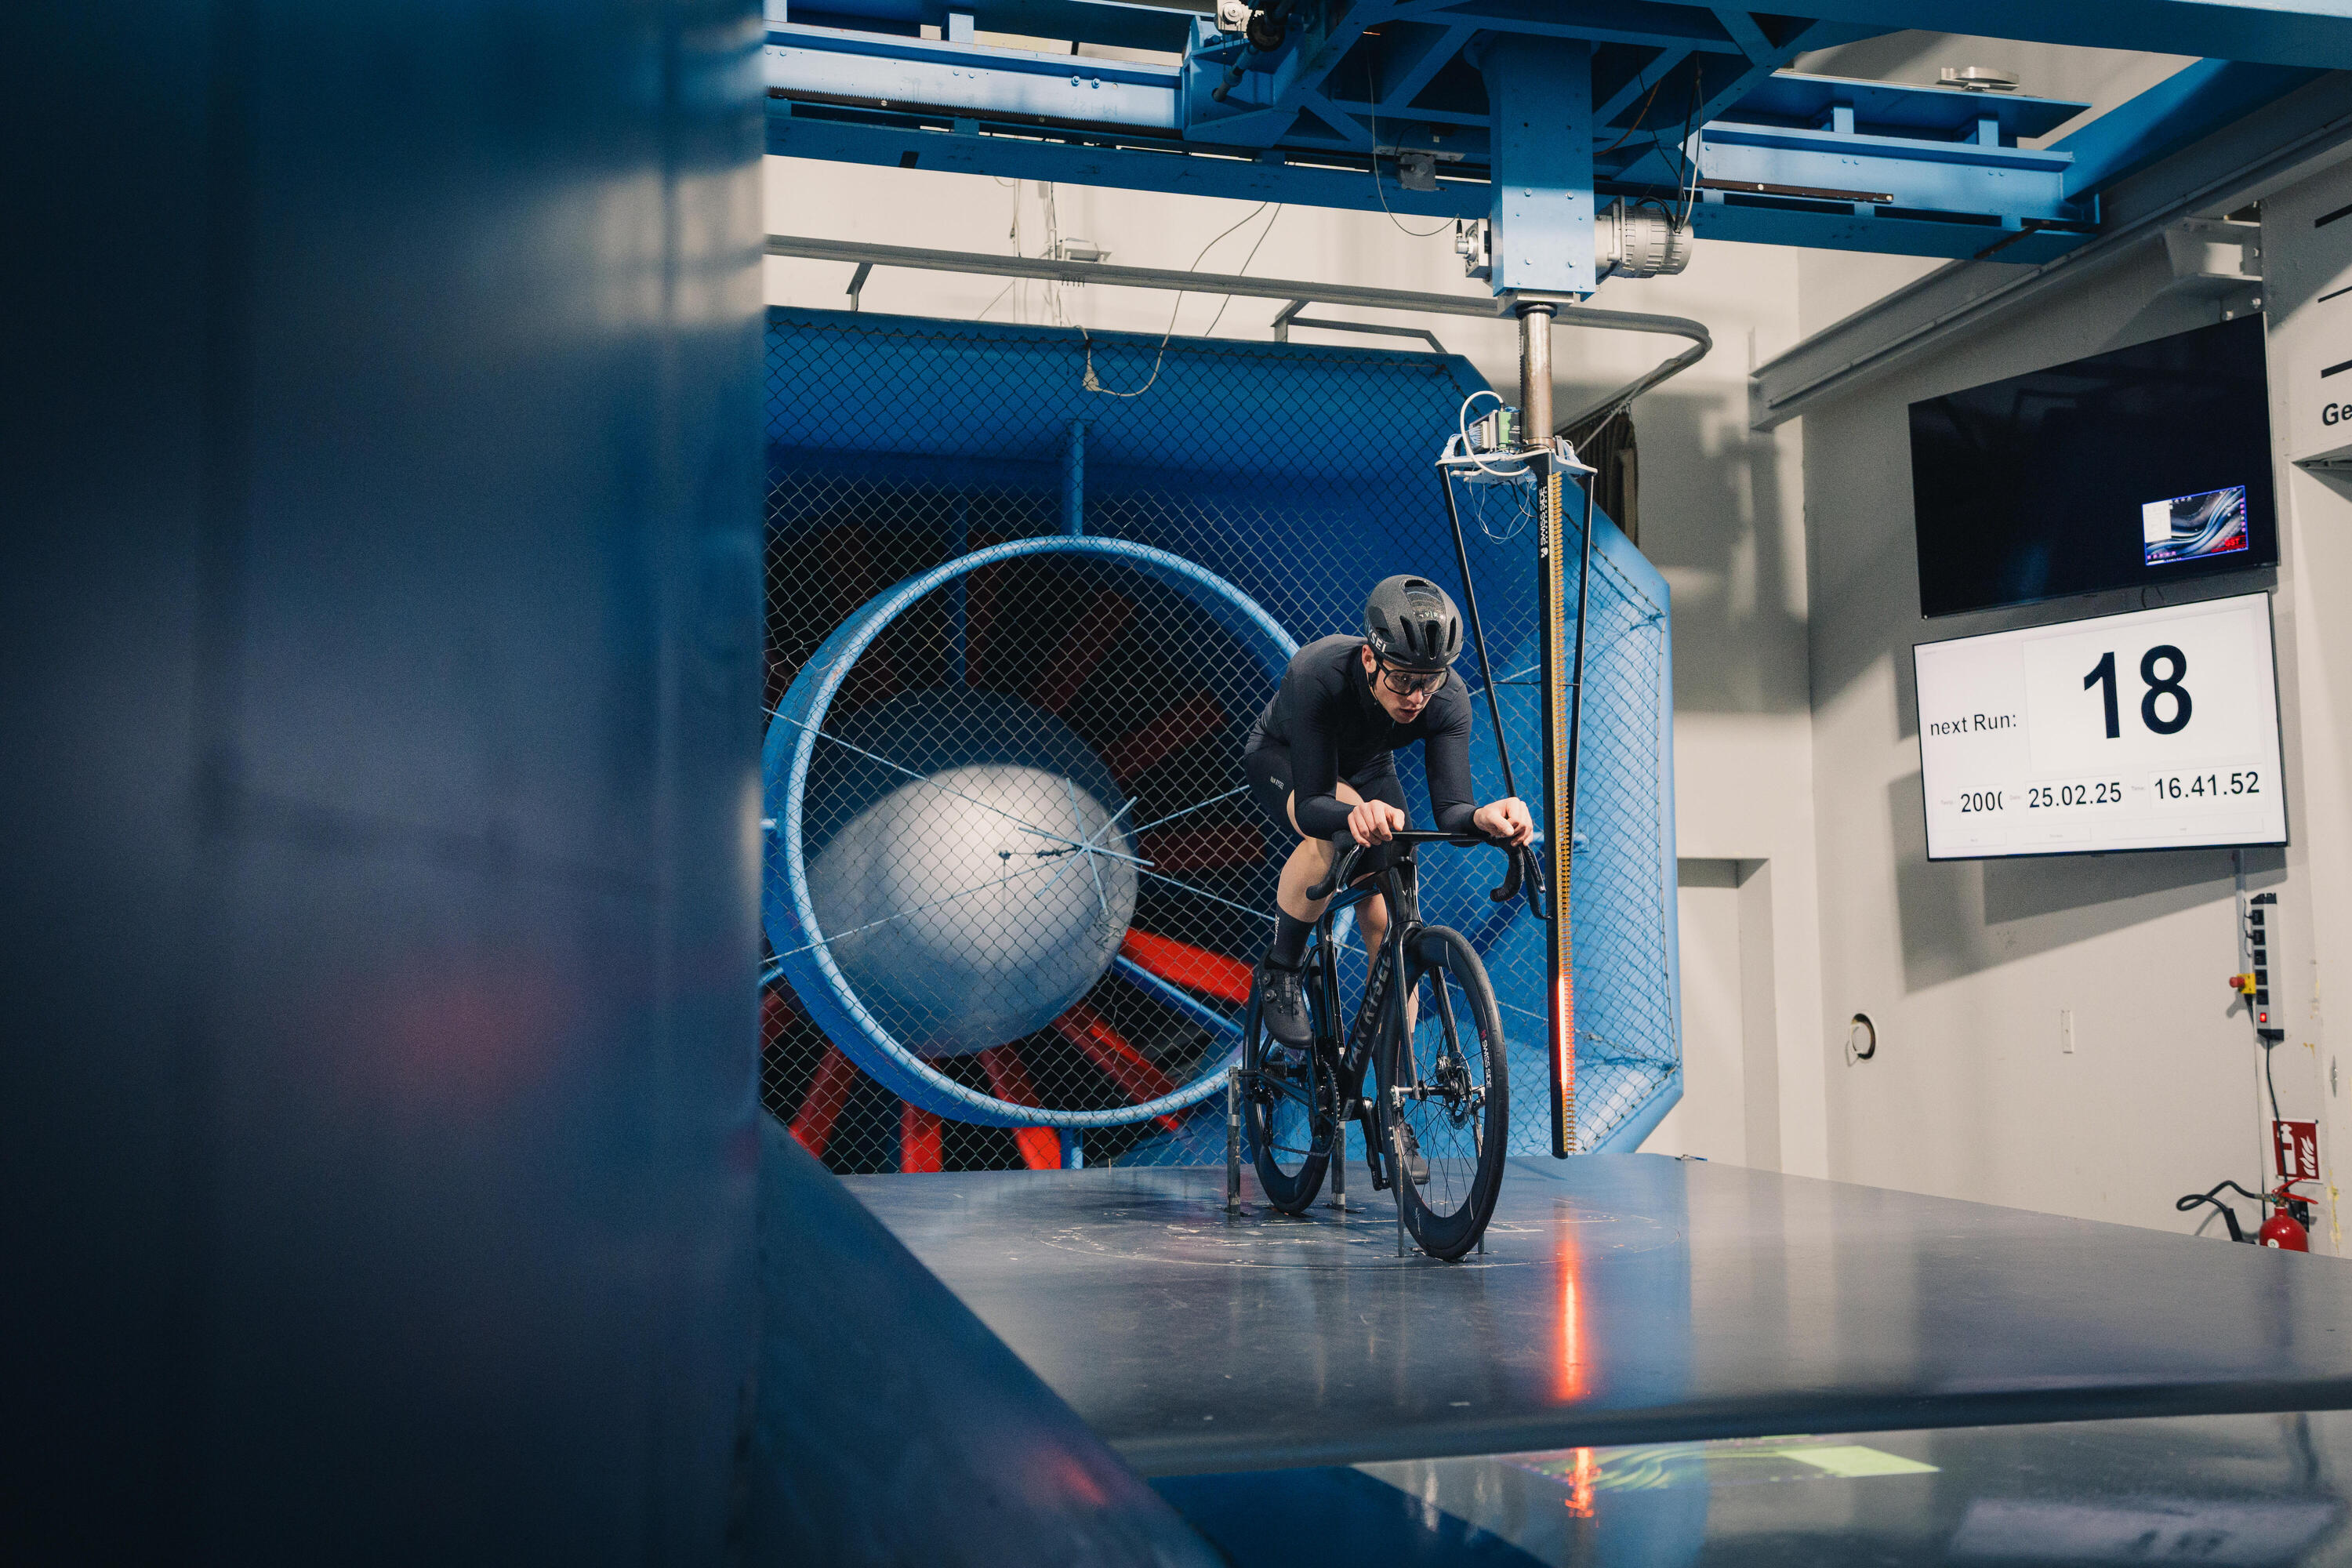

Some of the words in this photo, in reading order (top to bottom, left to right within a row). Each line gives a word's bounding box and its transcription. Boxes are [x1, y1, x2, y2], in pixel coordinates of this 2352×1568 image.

[2322, 403, 2352, 426] Ge
[2084, 645, 2192, 739] 18
[1930, 717, 1968, 736] next
[1973, 713, 2016, 731] Run:
[2029, 782, 2121, 808] 25.02.25
[2155, 771, 2259, 799] 16.41.52
[1482, 1040, 1490, 1068] SWISS
